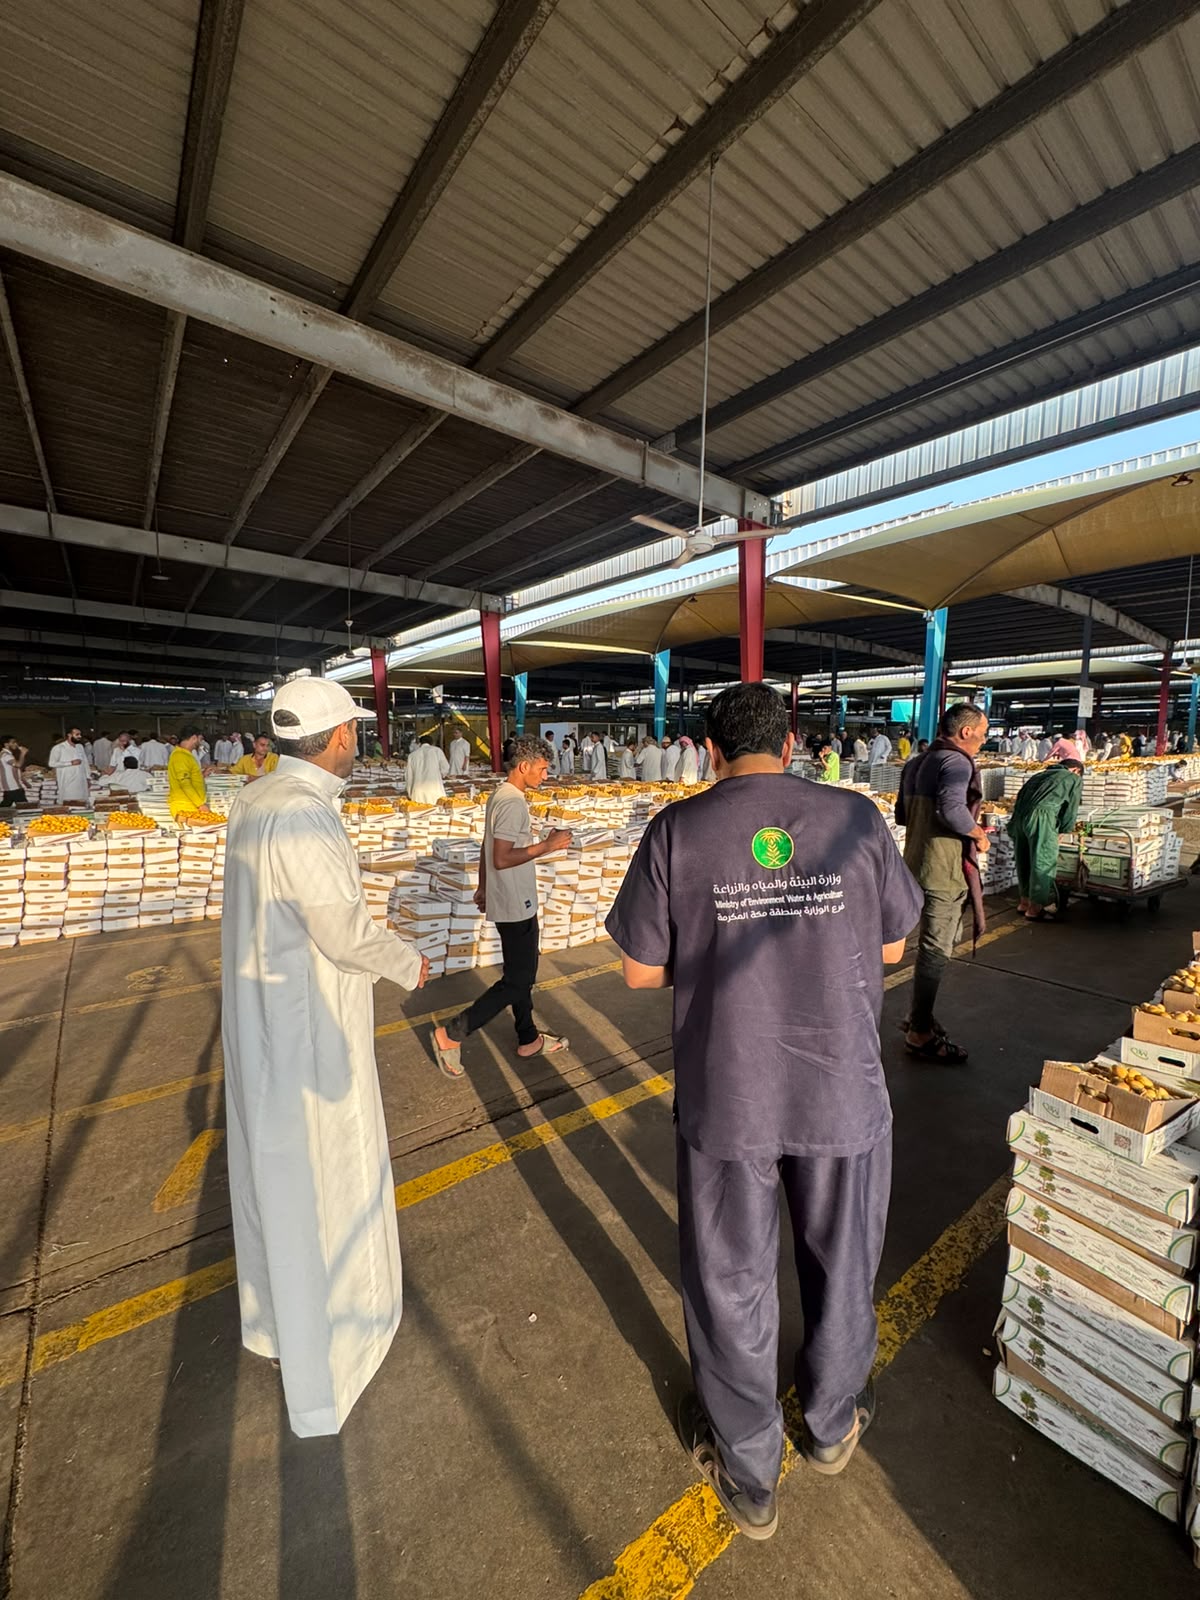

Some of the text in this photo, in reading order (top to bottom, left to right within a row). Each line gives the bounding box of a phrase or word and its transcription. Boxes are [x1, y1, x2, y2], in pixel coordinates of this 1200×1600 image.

[713, 873, 842, 895] وزارة البيئة والمياه والزراعة
[714, 899, 739, 910] Ministry
[740, 898, 748, 907] of
[786, 894, 805, 903] Water
[806, 893, 812, 902] &
[717, 902, 846, 923] فرع الوزارة بمنطقة مكة المكرمة
